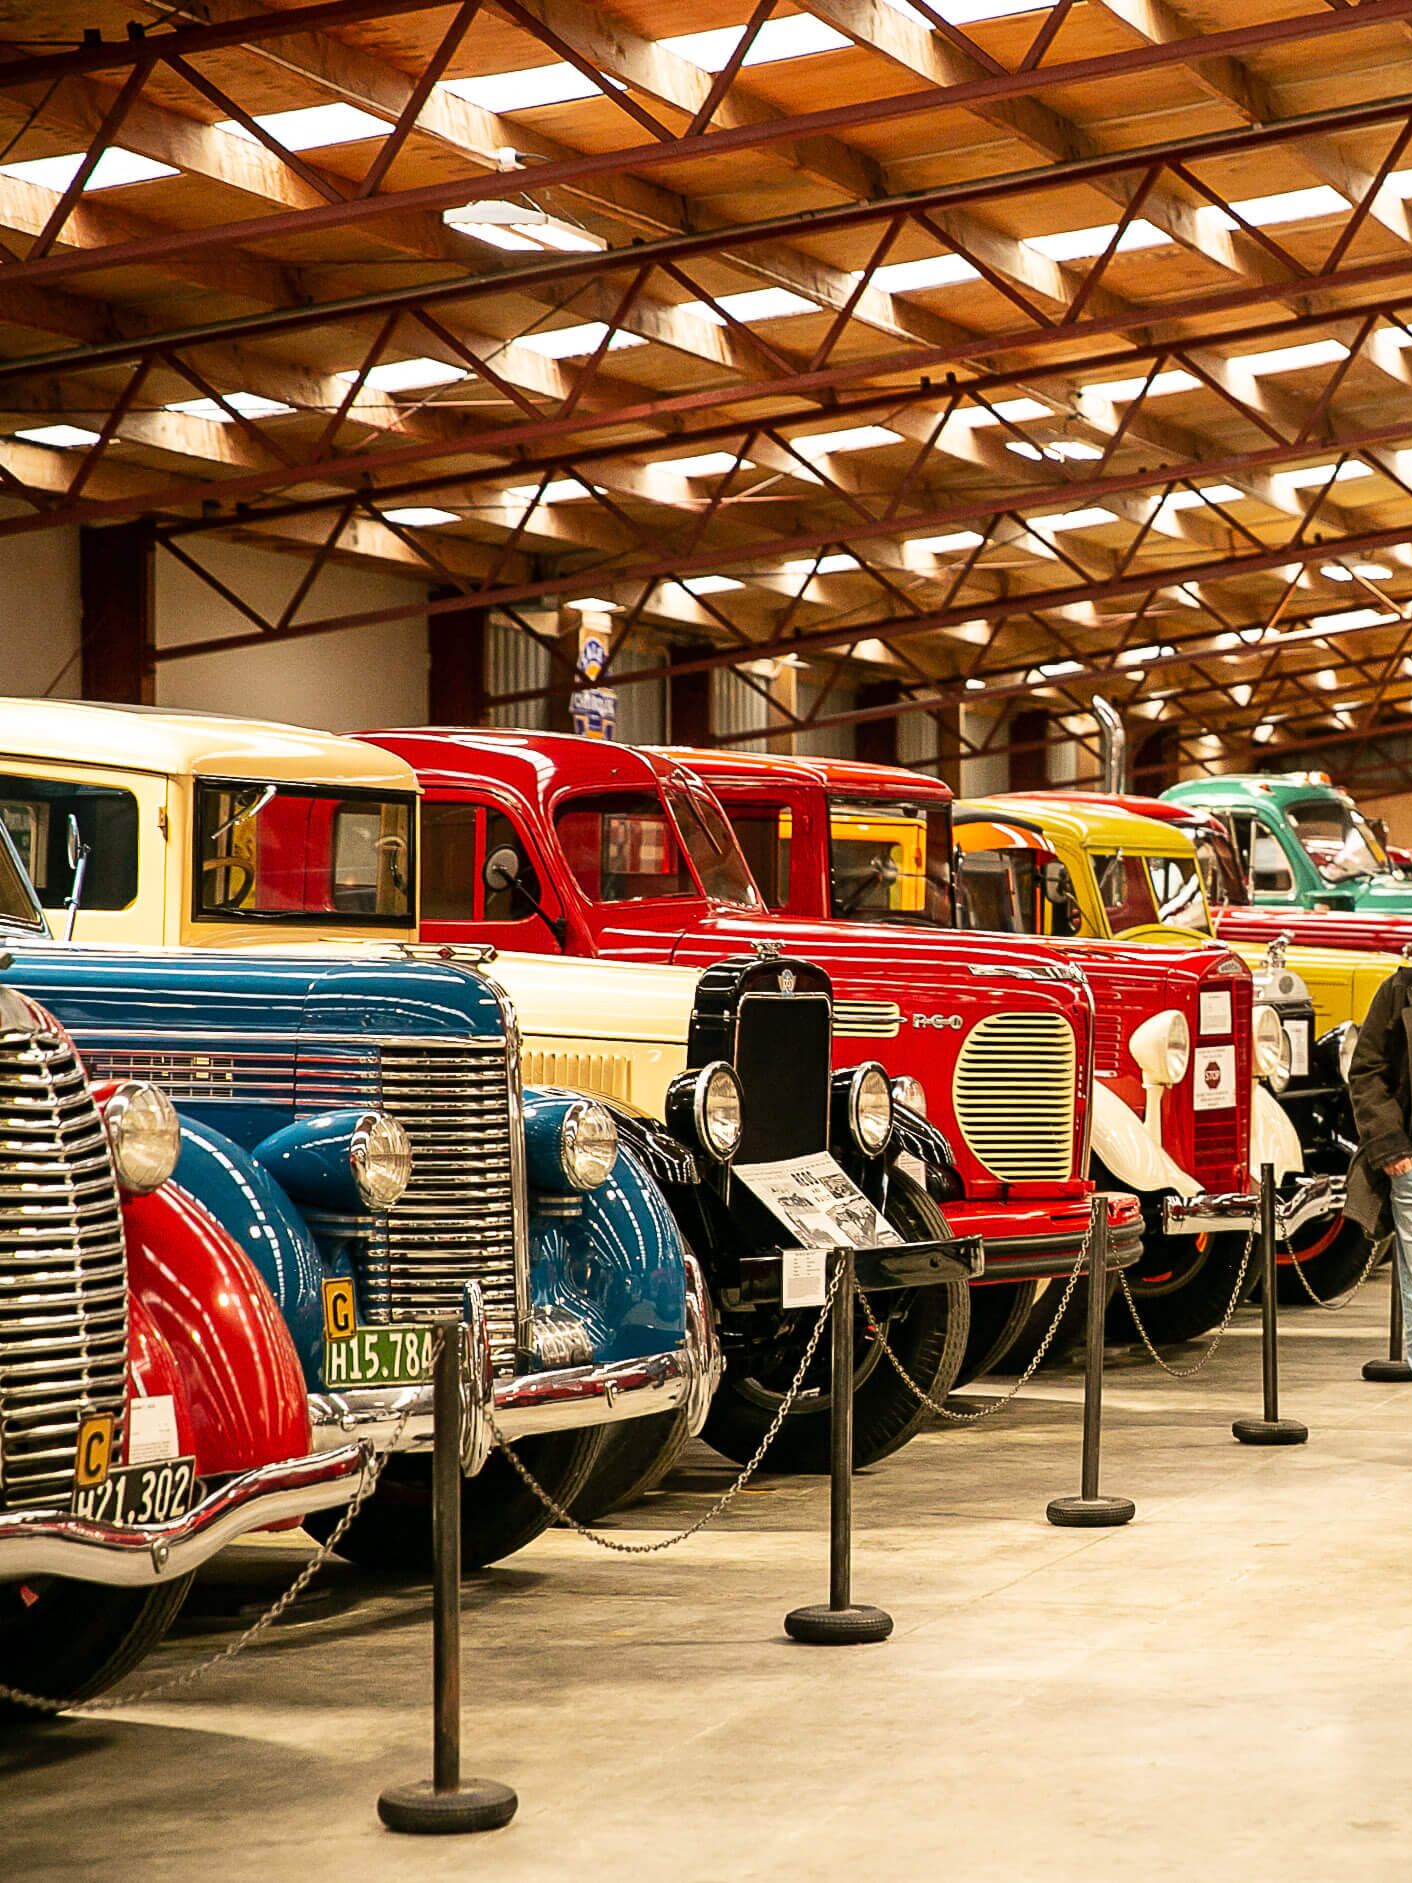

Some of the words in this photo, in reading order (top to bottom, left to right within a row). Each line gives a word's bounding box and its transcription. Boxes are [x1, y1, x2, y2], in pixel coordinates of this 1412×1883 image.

[1205, 1070, 1220, 1082] STOP
[332, 1291, 349, 1331] G
[85, 1431, 105, 1478] C
